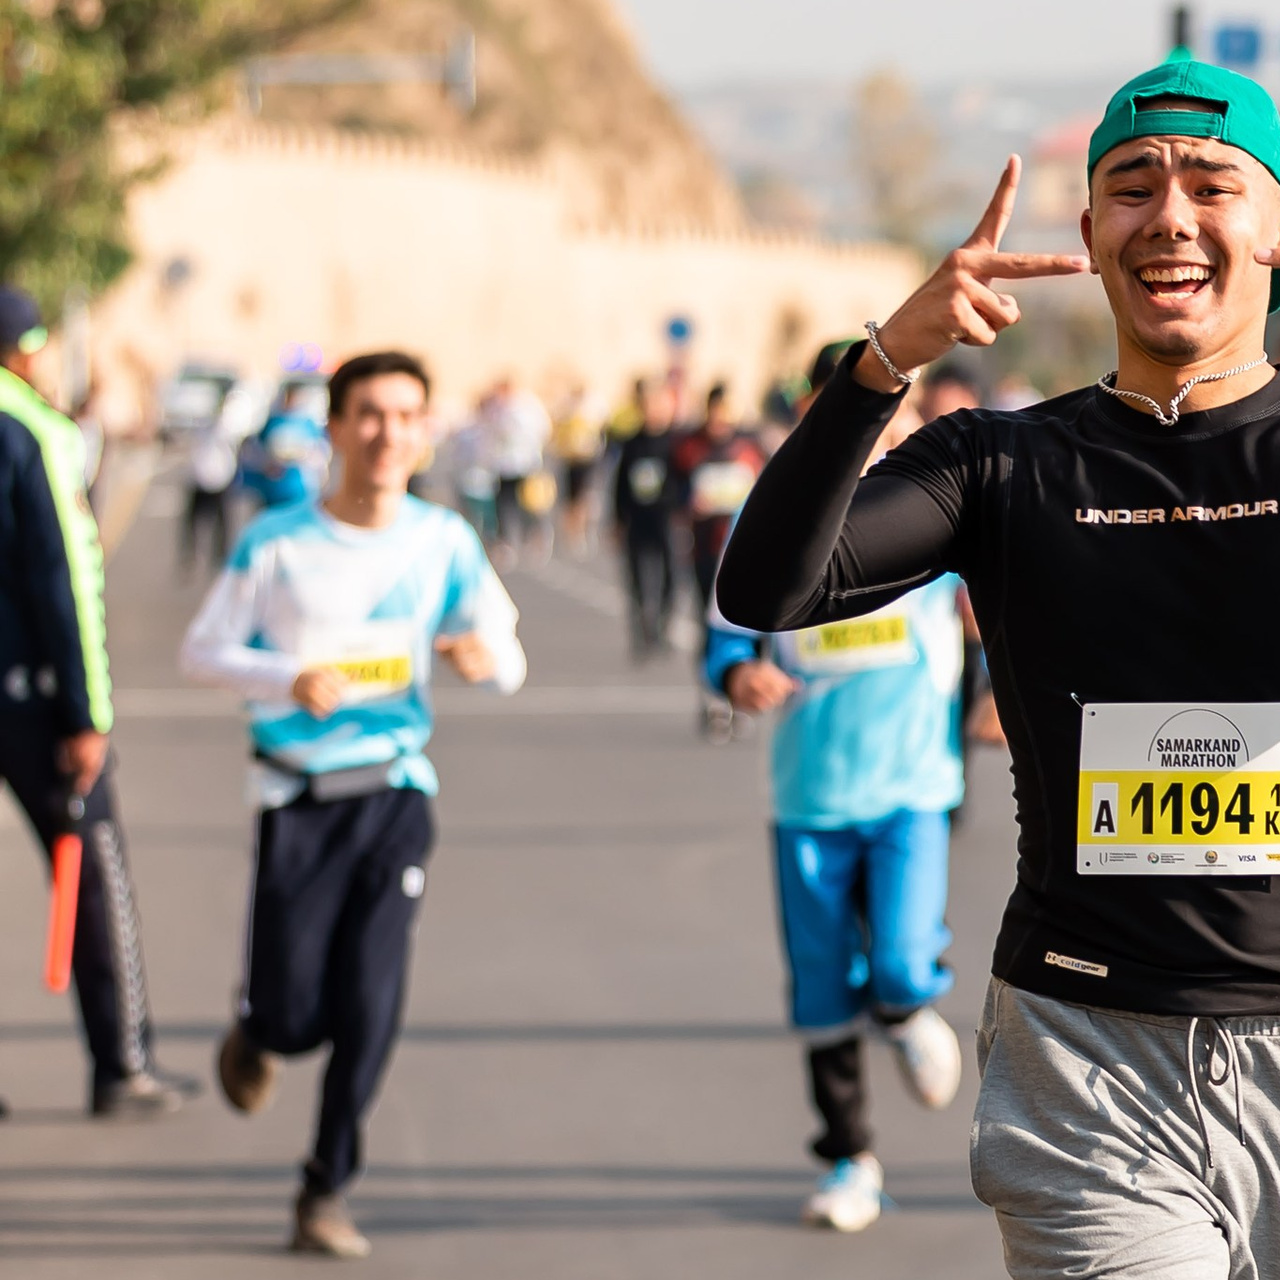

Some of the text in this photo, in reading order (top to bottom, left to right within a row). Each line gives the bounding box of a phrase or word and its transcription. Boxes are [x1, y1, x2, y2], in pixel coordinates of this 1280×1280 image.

[1075, 499, 1279, 524] UNDER ARMOUR
[1156, 738, 1240, 753] SAMARKAND
[1160, 753, 1236, 768] MARATHON
[1093, 781, 1255, 836] A 1194
[1237, 854, 1257, 863] VISA
